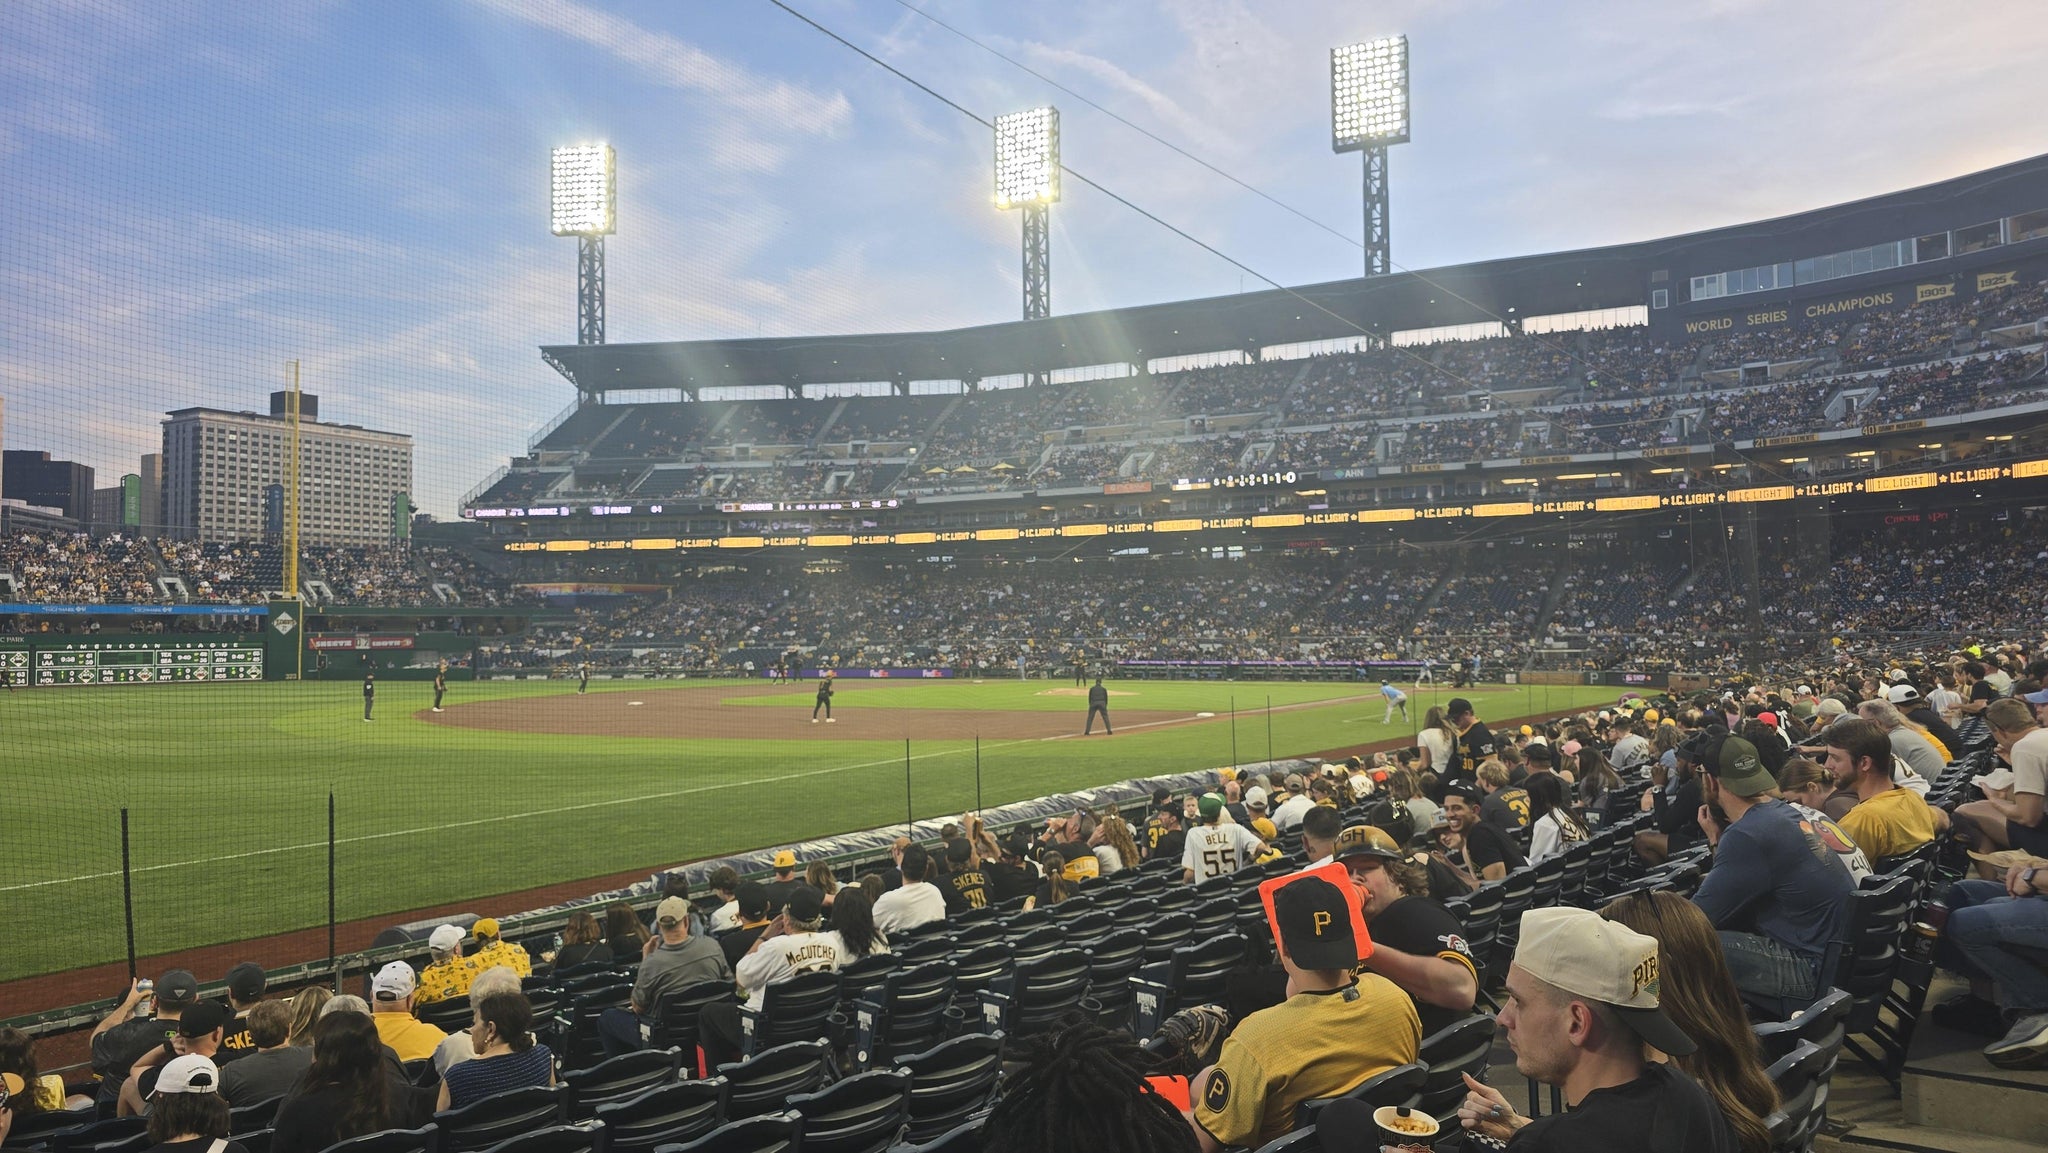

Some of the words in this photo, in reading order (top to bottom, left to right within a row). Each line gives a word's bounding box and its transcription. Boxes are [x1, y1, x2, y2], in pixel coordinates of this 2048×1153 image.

[1981, 275, 2007, 288] 1925
[1920, 287, 1947, 298] 1909
[1686, 318, 1732, 333] WORLD
[1747, 310, 1788, 326] SERIES
[1806, 292, 1894, 318] CHAMPIONS
[1862, 425, 1875, 436] 40
[1755, 438, 1765, 448] 21
[1262, 474, 1268, 484] 1
[1274, 472, 1281, 484] 1
[1286, 472, 1296, 483] 0
[1344, 468, 1364, 478] AHN
[1967, 468, 2000, 482] LIGHT
[1822, 482, 1854, 495] LIGHT
[1685, 493, 1716, 505] LIGHT
[1556, 501, 1585, 512] LIGHT
[870, 670, 888, 678] FedEx
[922, 670, 942, 678] FedEx
[1590, 672, 1598, 684] P
[1206, 833, 1228, 846] BELL
[1340, 829, 1365, 843] GH
[1203, 848, 1237, 878] 55
[952, 872, 984, 890] SKENES
[1312, 910, 1332, 936] P
[1209, 1078, 1224, 1099] P
